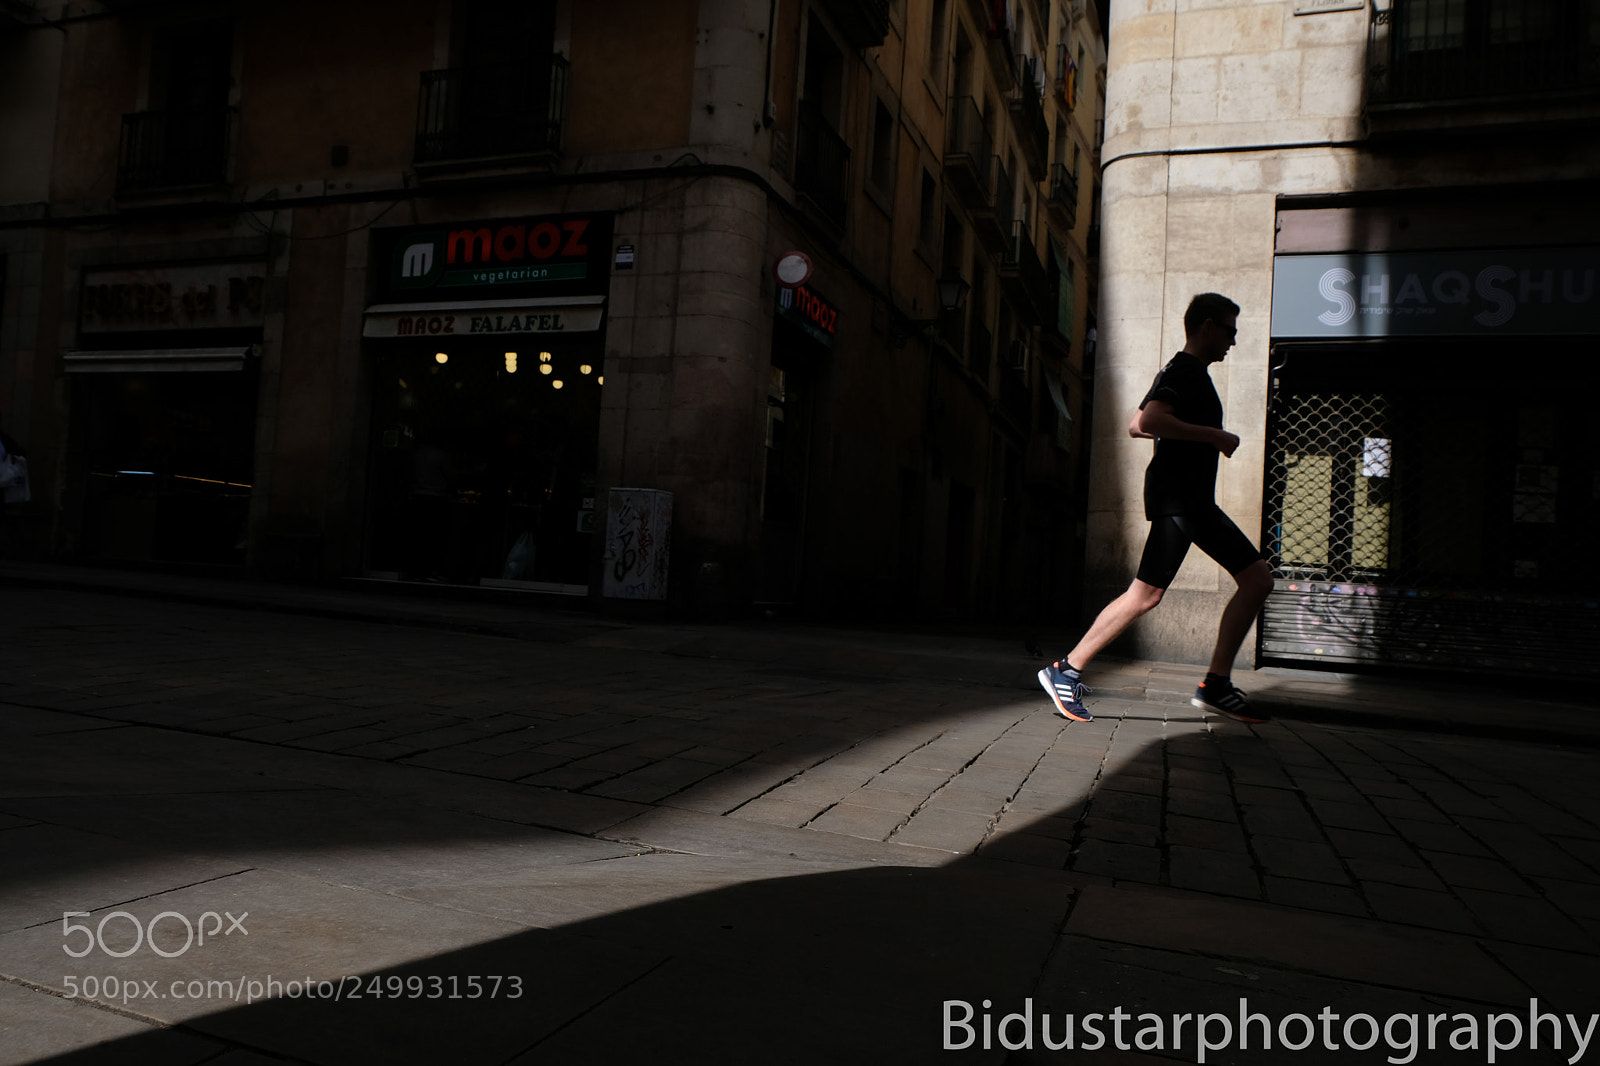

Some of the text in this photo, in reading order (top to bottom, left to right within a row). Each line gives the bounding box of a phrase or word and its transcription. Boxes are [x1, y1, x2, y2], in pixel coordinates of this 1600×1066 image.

[446, 218, 591, 265] maoz
[472, 267, 549, 284] vegetarian
[397, 314, 564, 334] MAOZ FALAFEL
[796, 286, 837, 334] maoz
